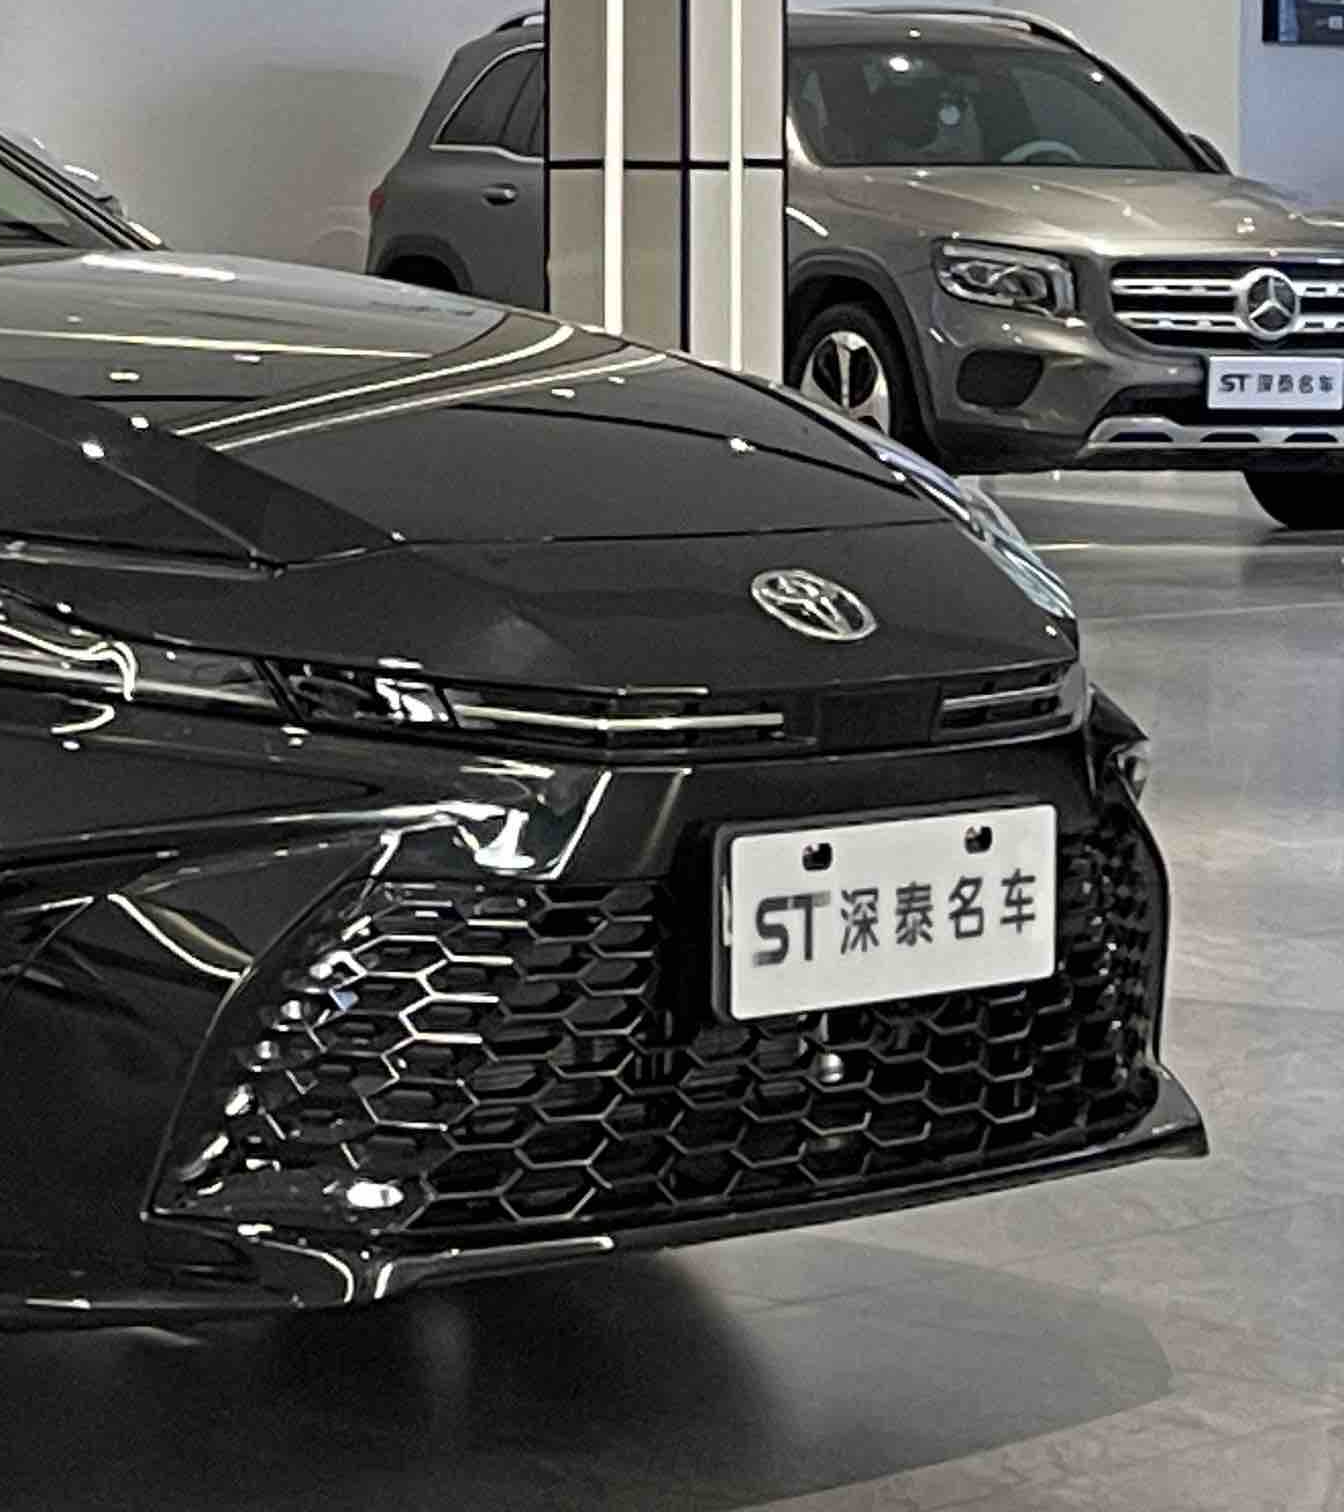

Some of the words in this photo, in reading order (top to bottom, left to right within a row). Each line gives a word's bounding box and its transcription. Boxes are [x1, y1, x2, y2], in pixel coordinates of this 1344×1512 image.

[1218, 373, 1251, 392] ST
[751, 890, 831, 967] ST
[840, 868, 1036, 955] 深泰名车
